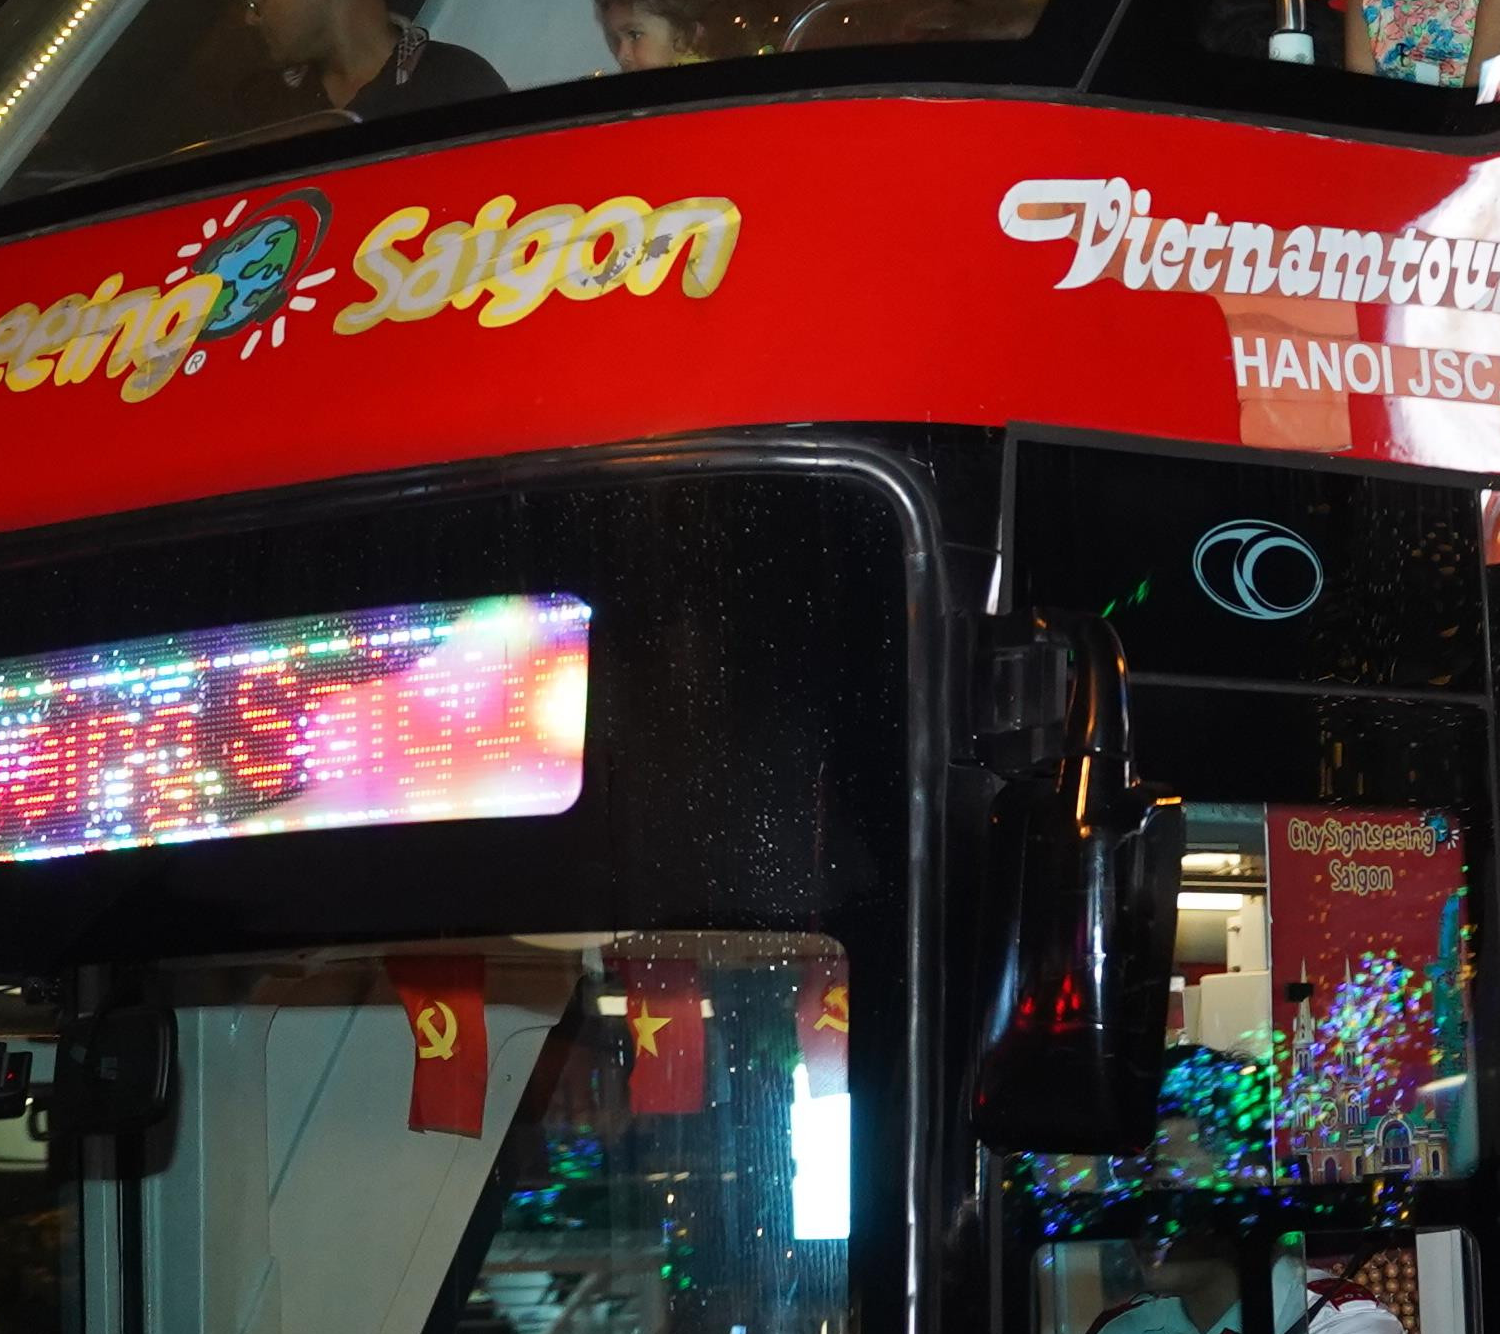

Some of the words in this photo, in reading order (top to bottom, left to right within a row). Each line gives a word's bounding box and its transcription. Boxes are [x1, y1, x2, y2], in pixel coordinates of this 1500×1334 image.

[334, 194, 742, 334] Saigon
[1232, 335, 1394, 395] HANOI
[1329, 858, 1393, 895] Saigon
